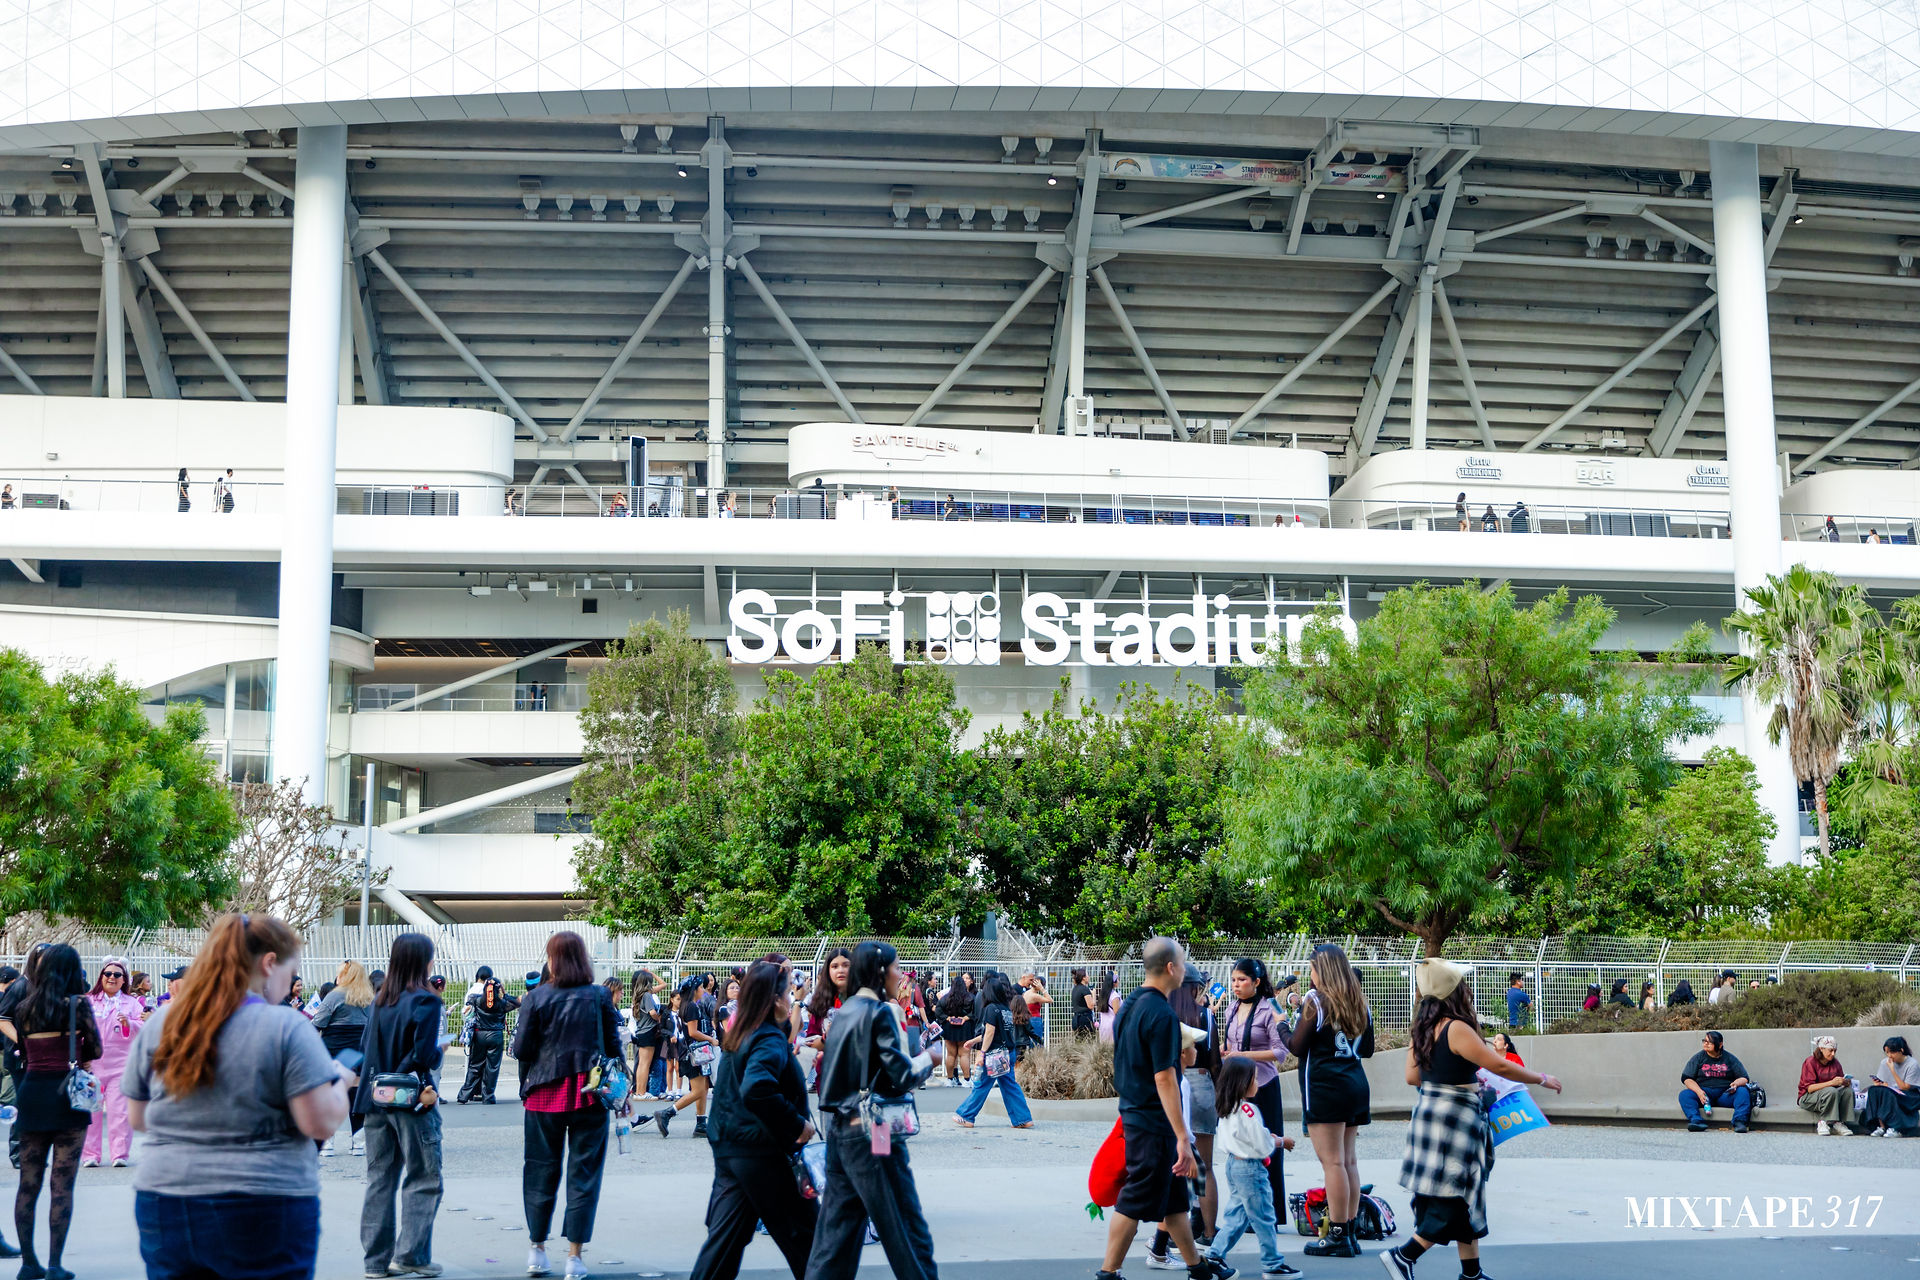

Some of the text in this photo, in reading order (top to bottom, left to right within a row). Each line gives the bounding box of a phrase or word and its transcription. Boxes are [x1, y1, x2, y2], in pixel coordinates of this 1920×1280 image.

[1331, 170, 1350, 178] Turner
[852, 434, 946, 452] SAWTELLE
[1461, 468, 1498, 477] TRADICIONAL
[1576, 466, 1616, 481] BAR
[727, 588, 1358, 667] SoFi Stadium
[1241, 1103, 1255, 1118] 9
[1490, 1109, 1533, 1134] IDOL
